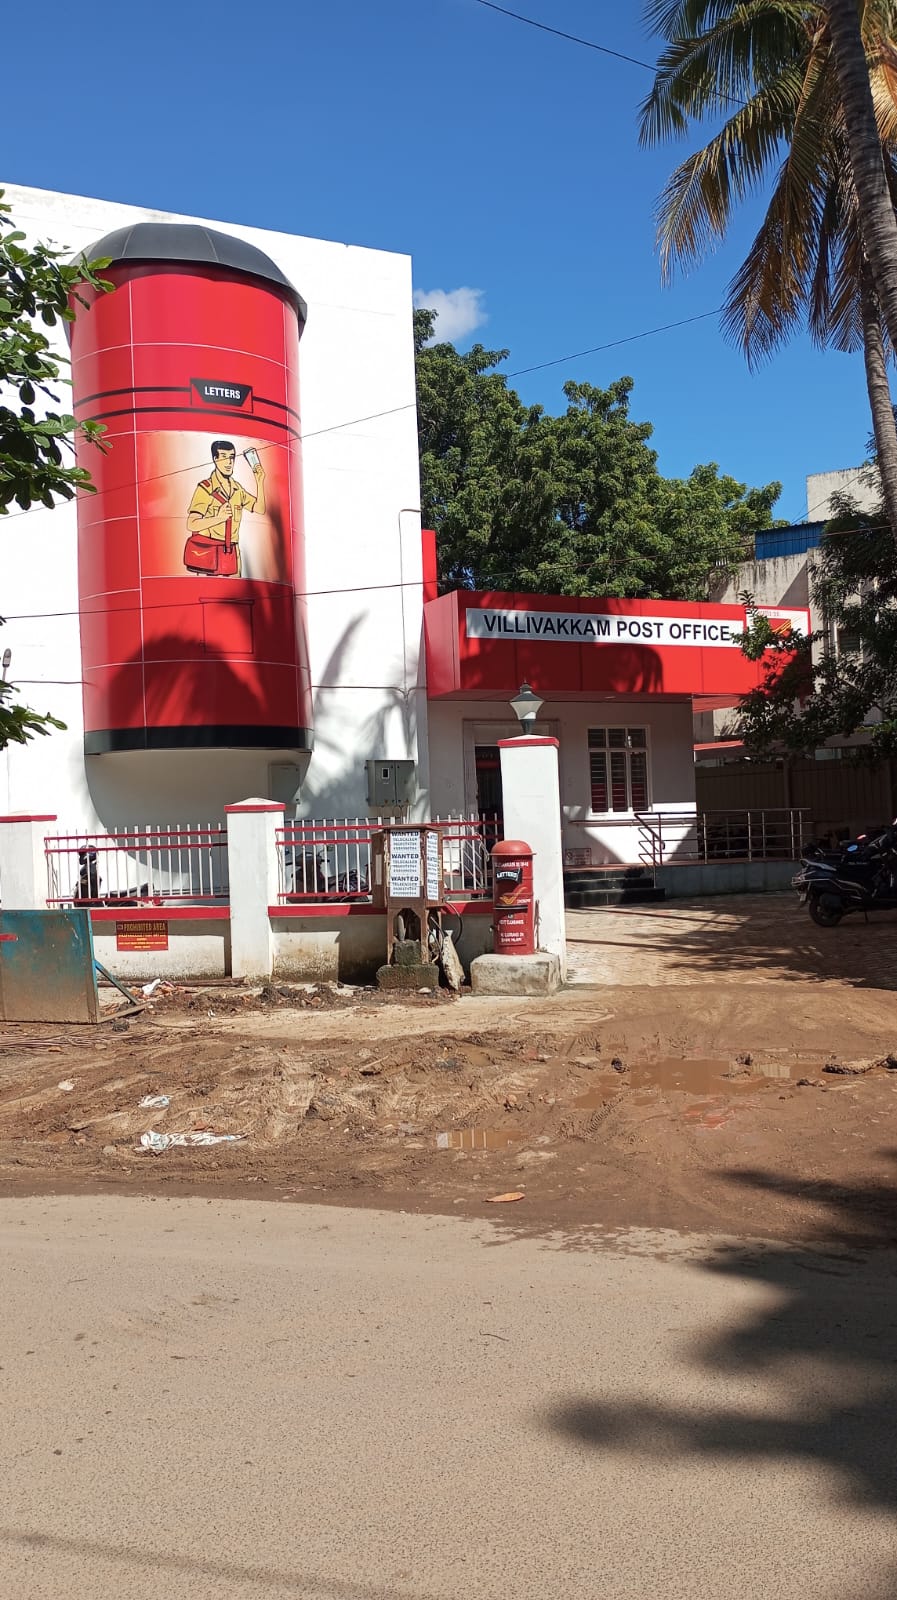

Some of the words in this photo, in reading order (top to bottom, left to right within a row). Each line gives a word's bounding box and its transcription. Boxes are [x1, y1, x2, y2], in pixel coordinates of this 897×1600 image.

[204, 386, 241, 399] LETTERS
[483, 614, 612, 637] VILLIVAKKAM
[616, 620, 665, 639] POST
[668, 623, 731, 641] OFFICE
[124, 923, 152, 931] PROHIBITED
[153, 922, 166, 931] AREA
